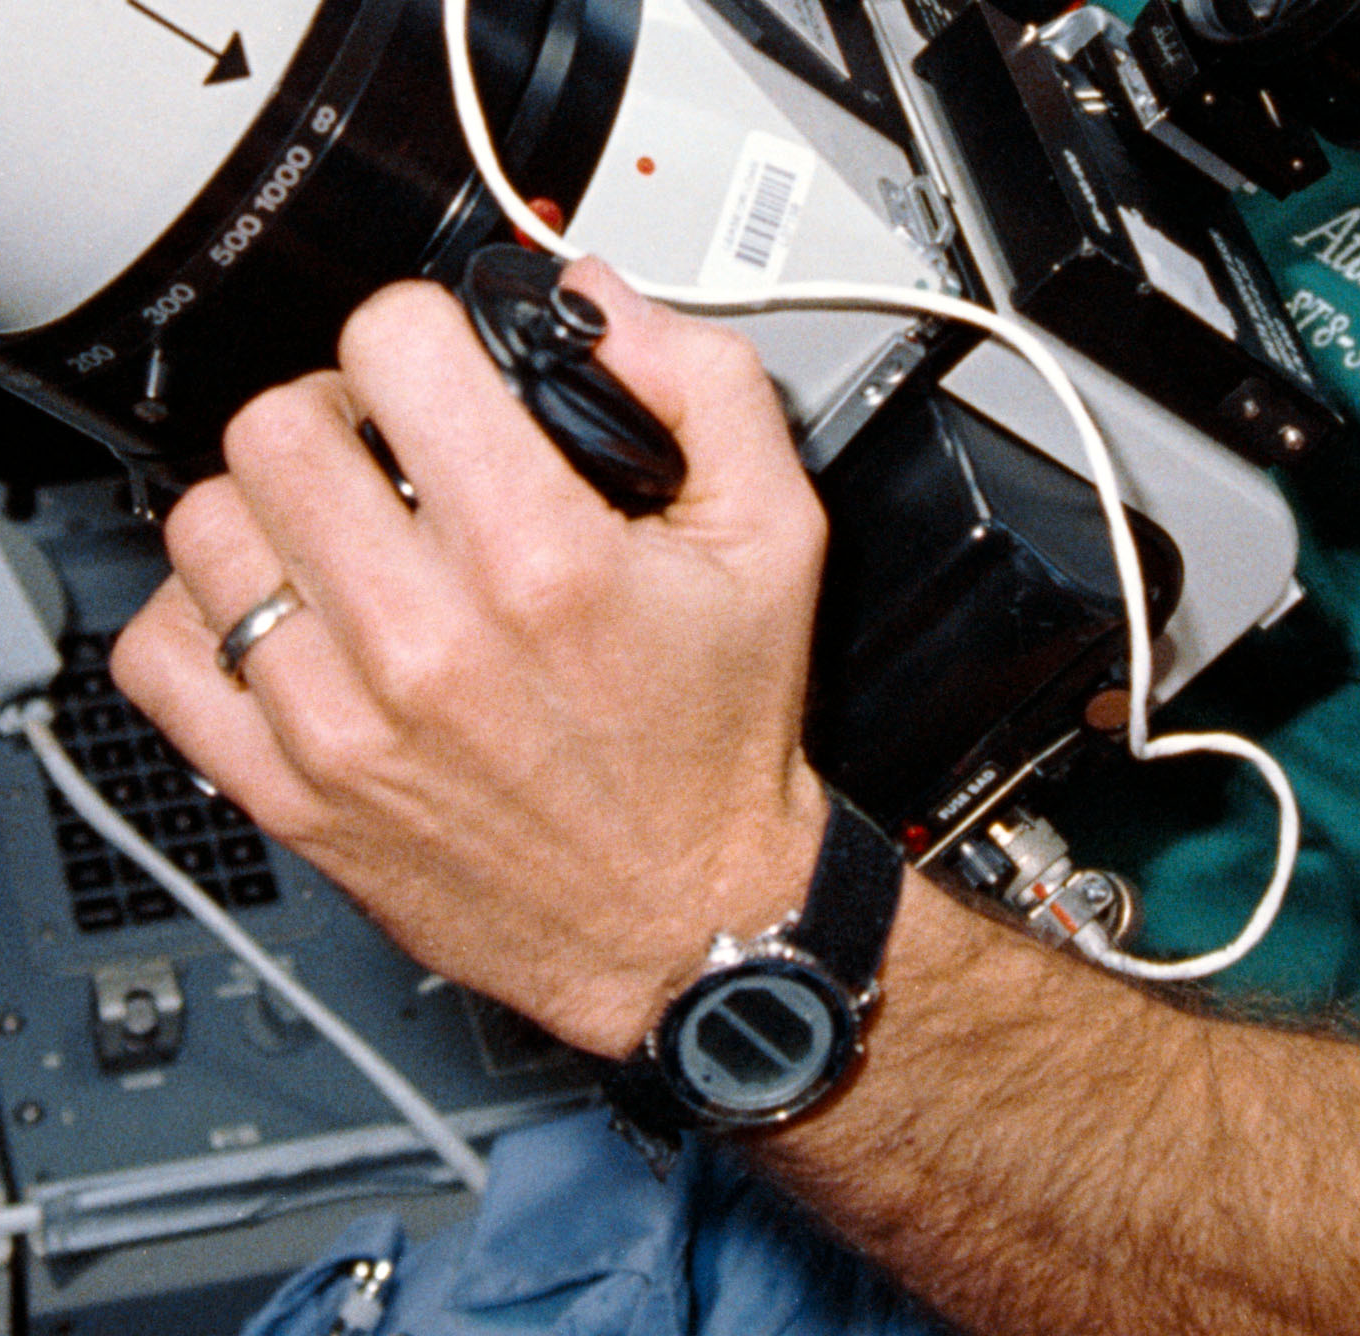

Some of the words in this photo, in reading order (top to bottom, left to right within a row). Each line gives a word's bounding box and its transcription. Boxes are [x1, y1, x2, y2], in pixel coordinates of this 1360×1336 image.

[66, 343, 116, 373] 200
[142, 282, 196, 326] 300
[208, 213, 263, 266] 500
[253, 145, 312, 213] 1000
[938, 791, 971, 820] FUSE
[966, 769, 997, 795] BAD
